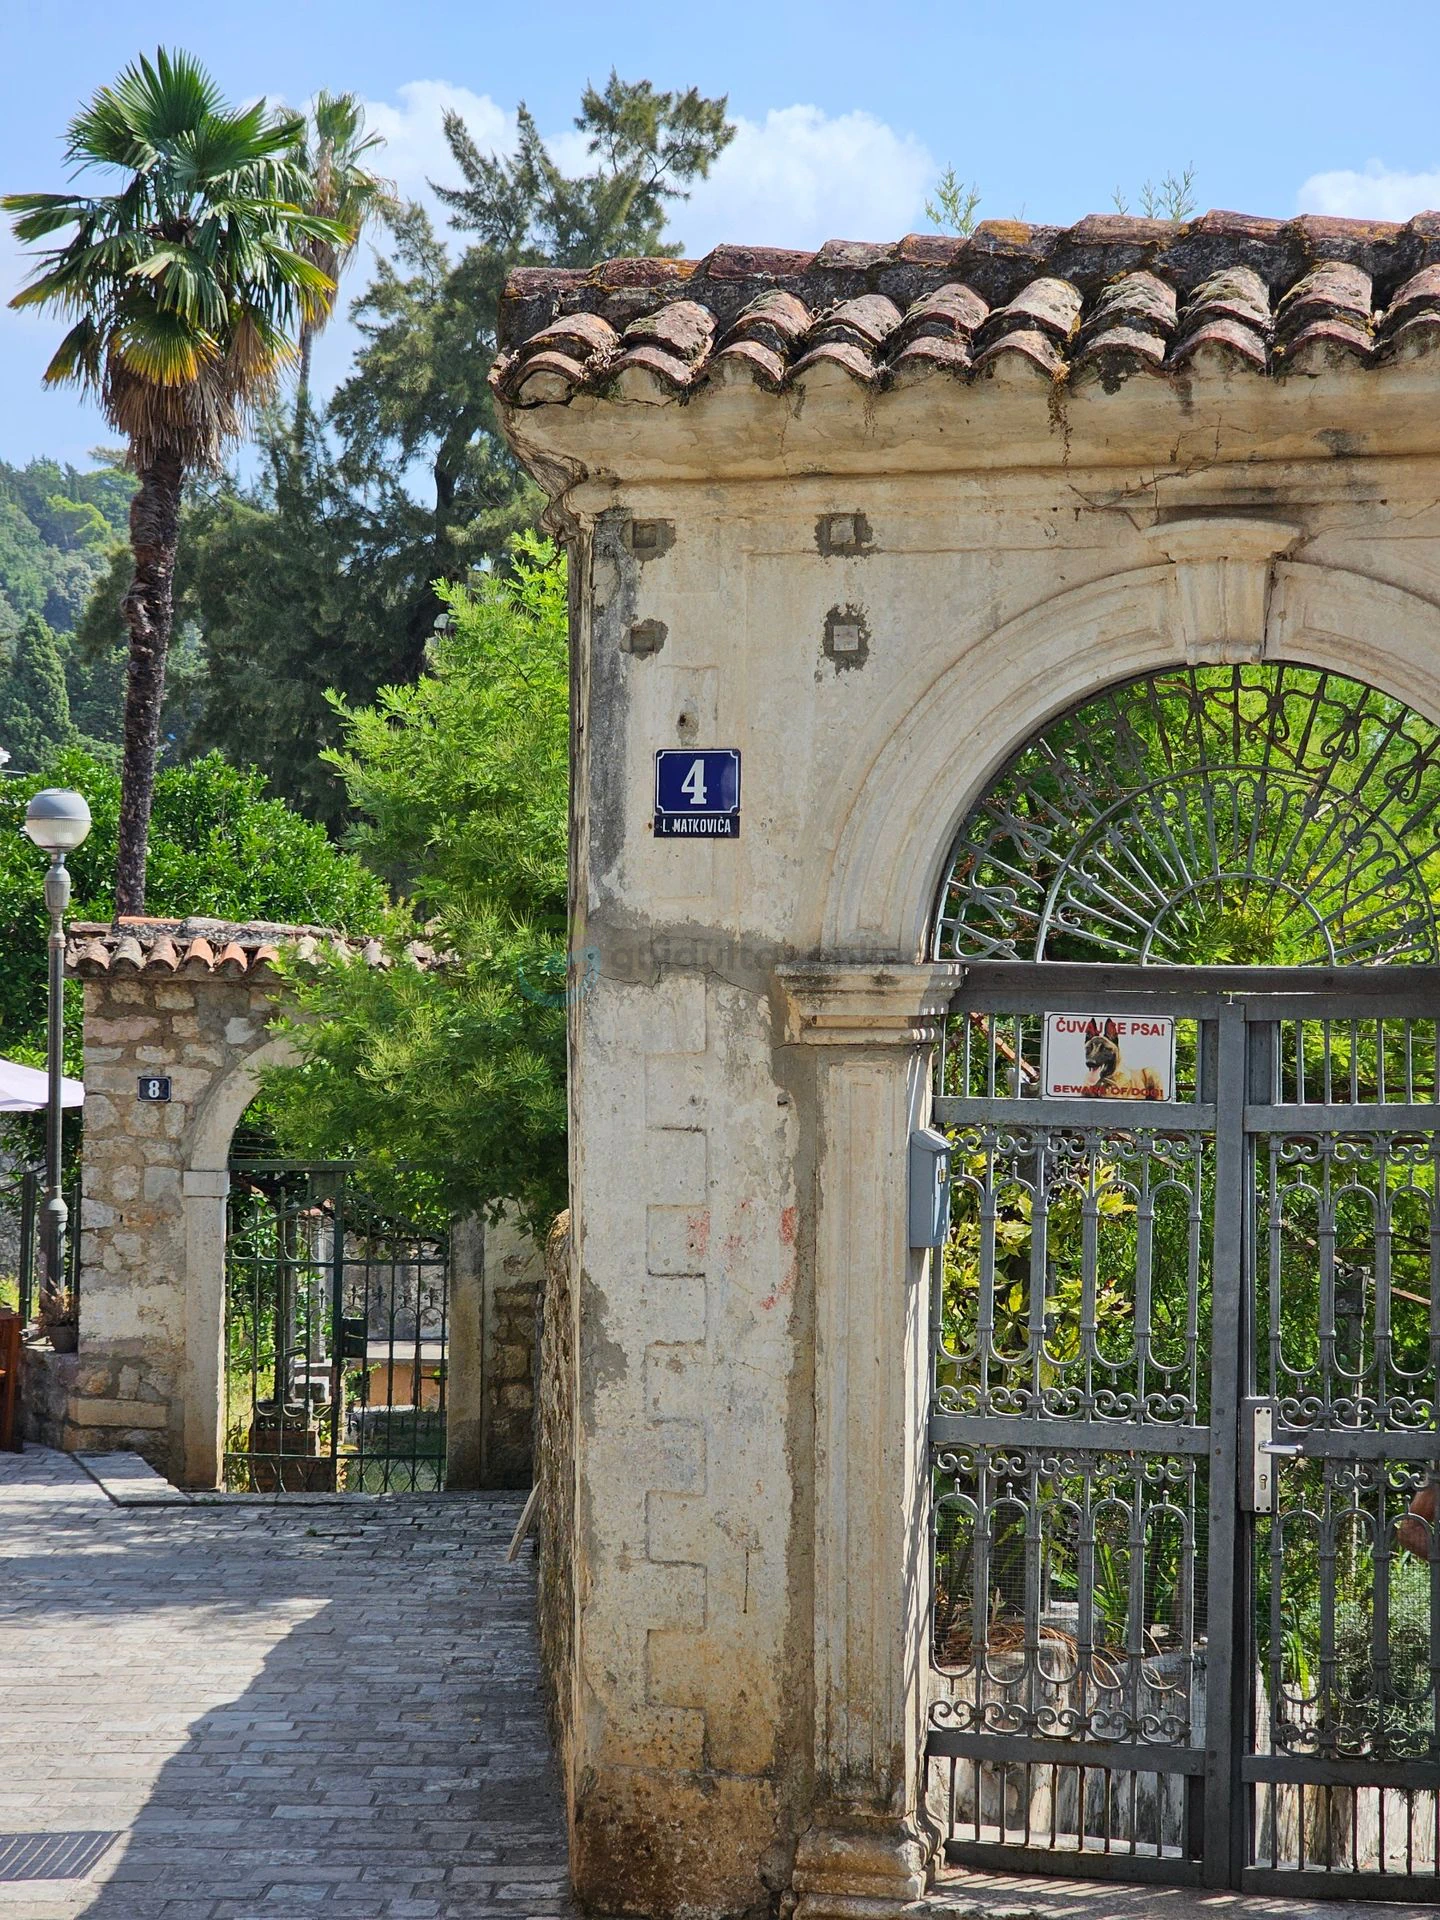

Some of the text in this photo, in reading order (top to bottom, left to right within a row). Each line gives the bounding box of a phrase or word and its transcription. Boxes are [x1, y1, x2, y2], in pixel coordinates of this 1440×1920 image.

[681, 759, 707, 804] 4
[662, 818, 670, 833] L.
[1131, 1023, 1165, 1036] PSA!
[148, 1080, 160, 1098] 8
